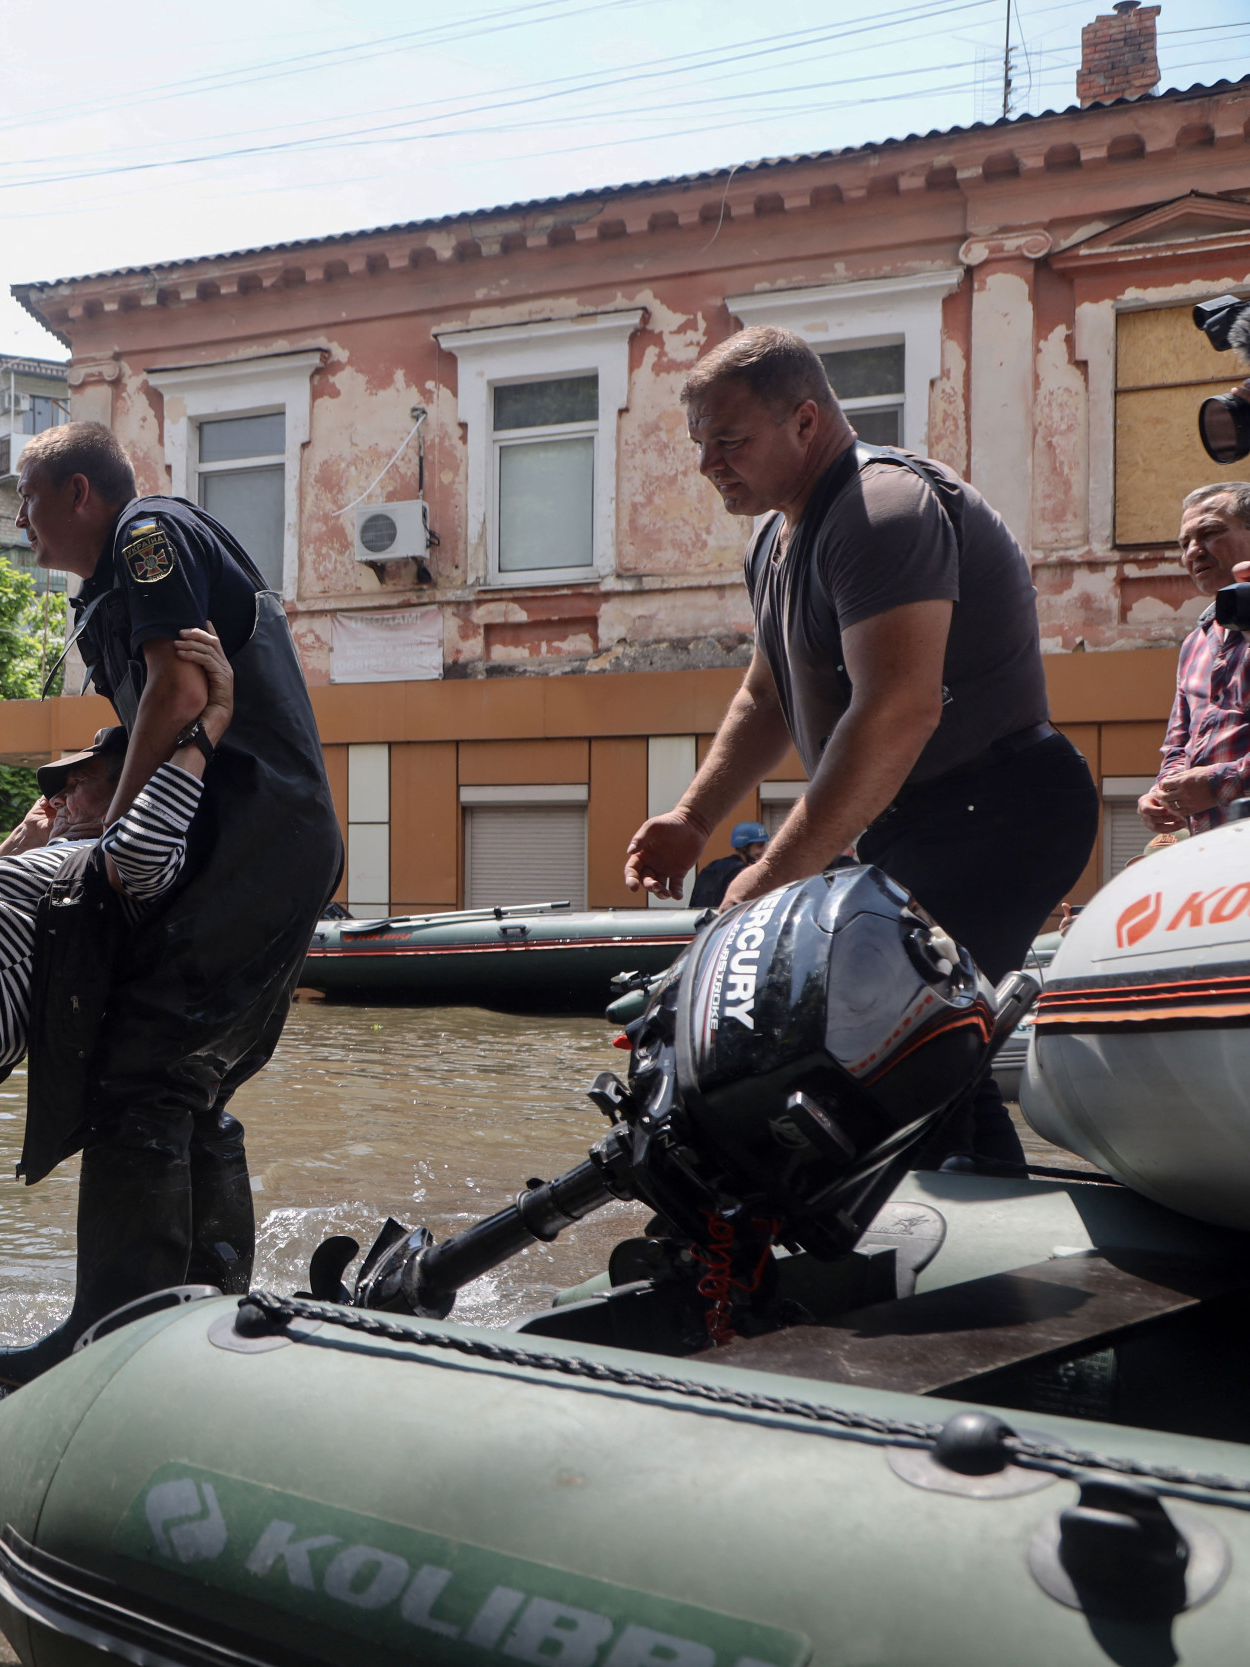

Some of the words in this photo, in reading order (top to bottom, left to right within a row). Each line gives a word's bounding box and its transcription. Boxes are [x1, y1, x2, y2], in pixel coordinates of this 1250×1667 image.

[127, 535, 164, 556] УКРАЇНА
[1165, 881, 1250, 932] KO
[710, 922, 741, 1031] FOURSTROKE
[244, 1518, 780, 1667] KOLIB
